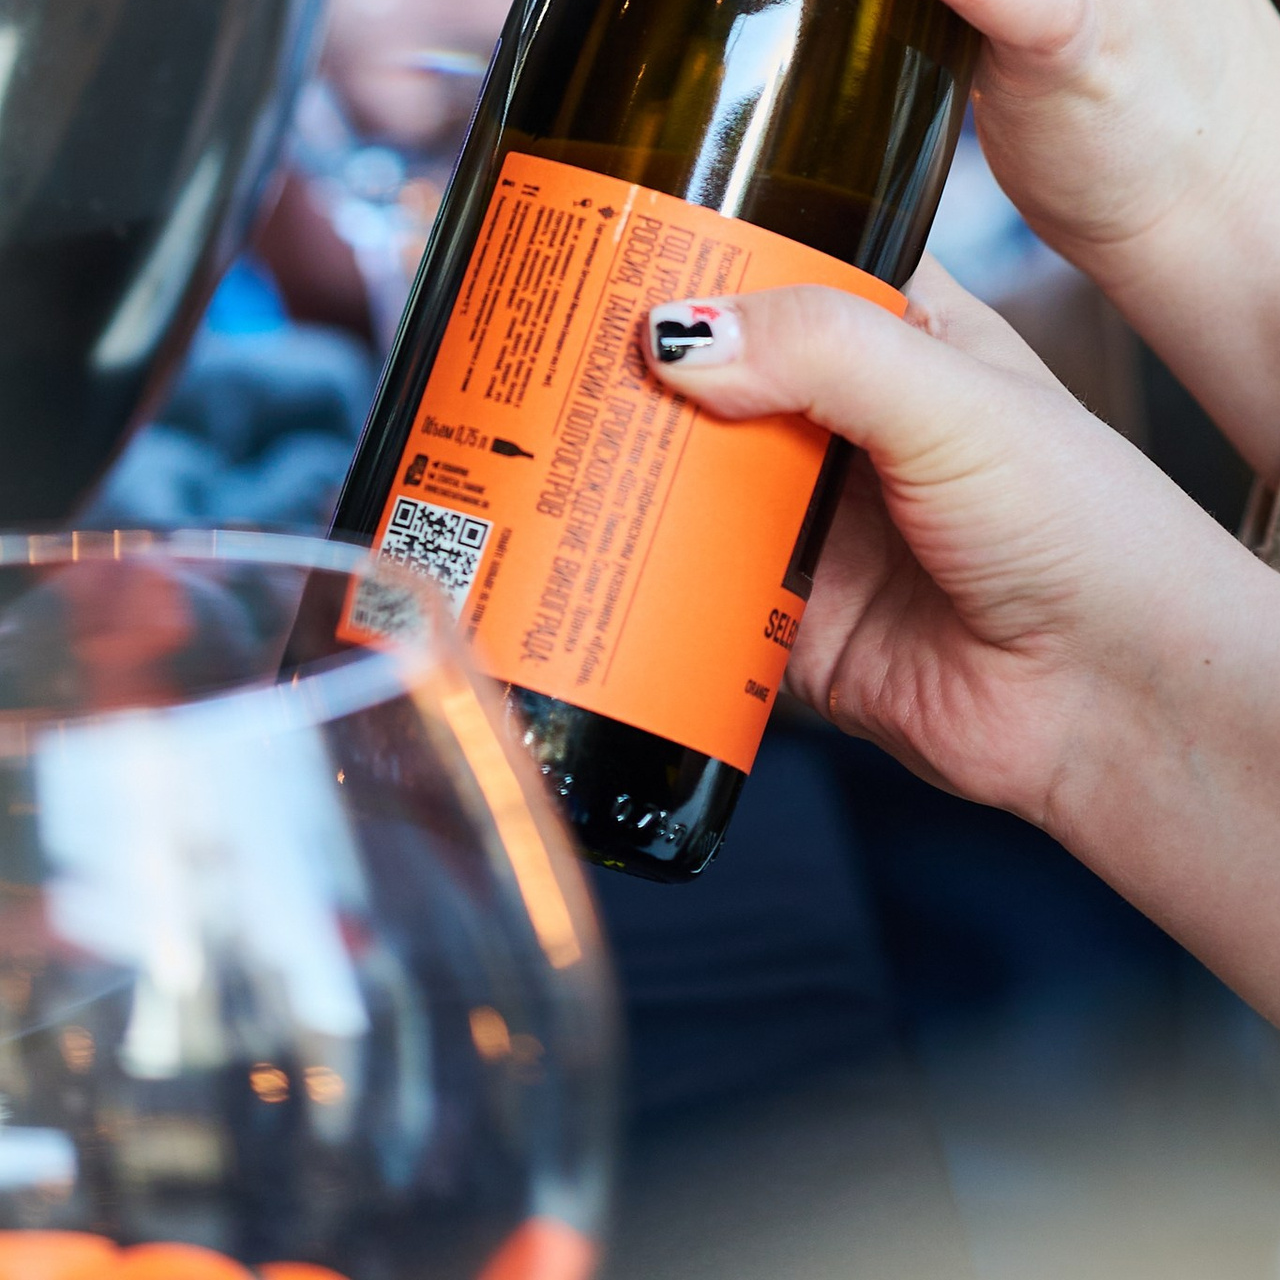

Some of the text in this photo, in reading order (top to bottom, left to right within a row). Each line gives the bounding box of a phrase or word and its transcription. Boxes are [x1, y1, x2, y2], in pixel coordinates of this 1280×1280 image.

[608, 211, 663, 293] РОССИЯ,
[657, 223, 695, 265] ГОД
[575, 292, 639, 403] ТАМАНСКИЙ
[455, 424, 480, 447] 0,75
[534, 399, 600, 520] ПОЛУОСТРОВ
[554, 393, 637, 560] ПРОИСХОЖДЕНИЕ
[516, 553, 581, 668] ВИНОГРАДА:
[744, 679, 770, 703] ORANGE
